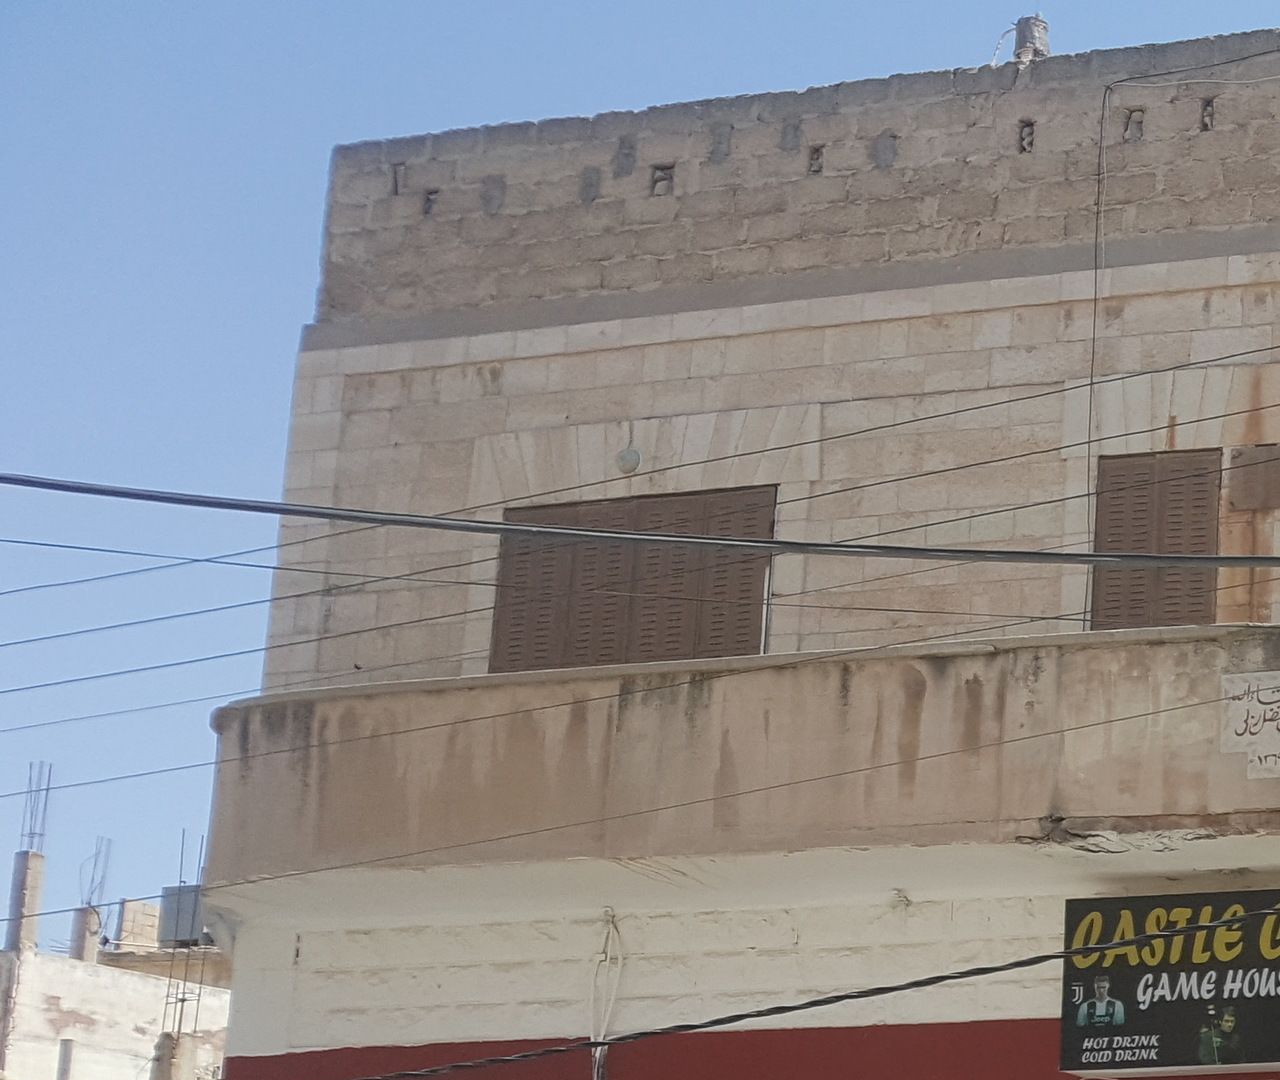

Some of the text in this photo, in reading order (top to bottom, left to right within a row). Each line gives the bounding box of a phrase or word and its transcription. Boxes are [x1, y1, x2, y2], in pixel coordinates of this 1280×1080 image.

[1071, 904, 1246, 969] CASTLE
[1136, 970, 1217, 1010] GAME
[1081, 1048, 1159, 1063] COLD DRINK
[1082, 1034, 1160, 1050] HOT DRINK
